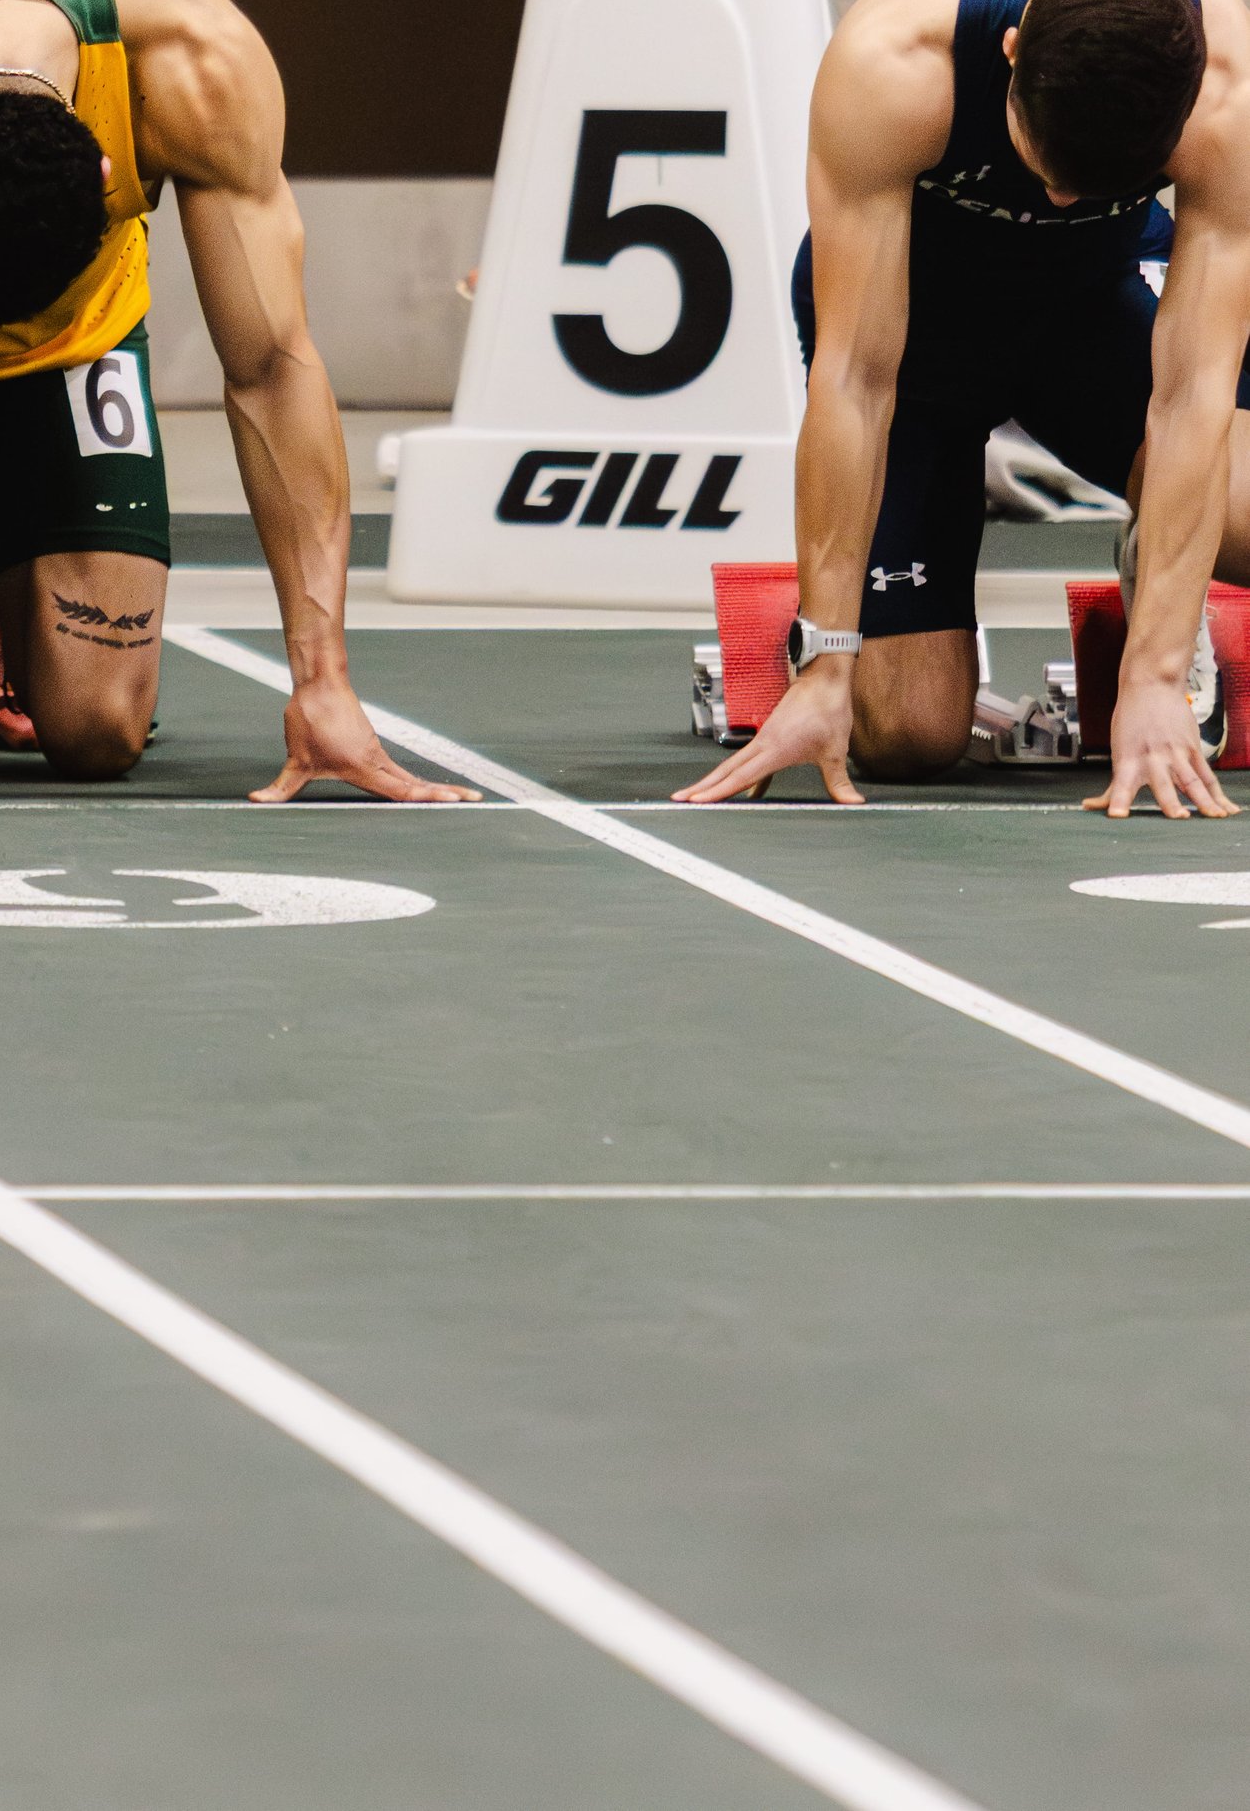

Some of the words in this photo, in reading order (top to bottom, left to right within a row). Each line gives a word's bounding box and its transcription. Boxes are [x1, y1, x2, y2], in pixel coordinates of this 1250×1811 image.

[552, 109, 732, 397] 5
[85, 358, 135, 448] 6
[495, 450, 743, 531] GILL
